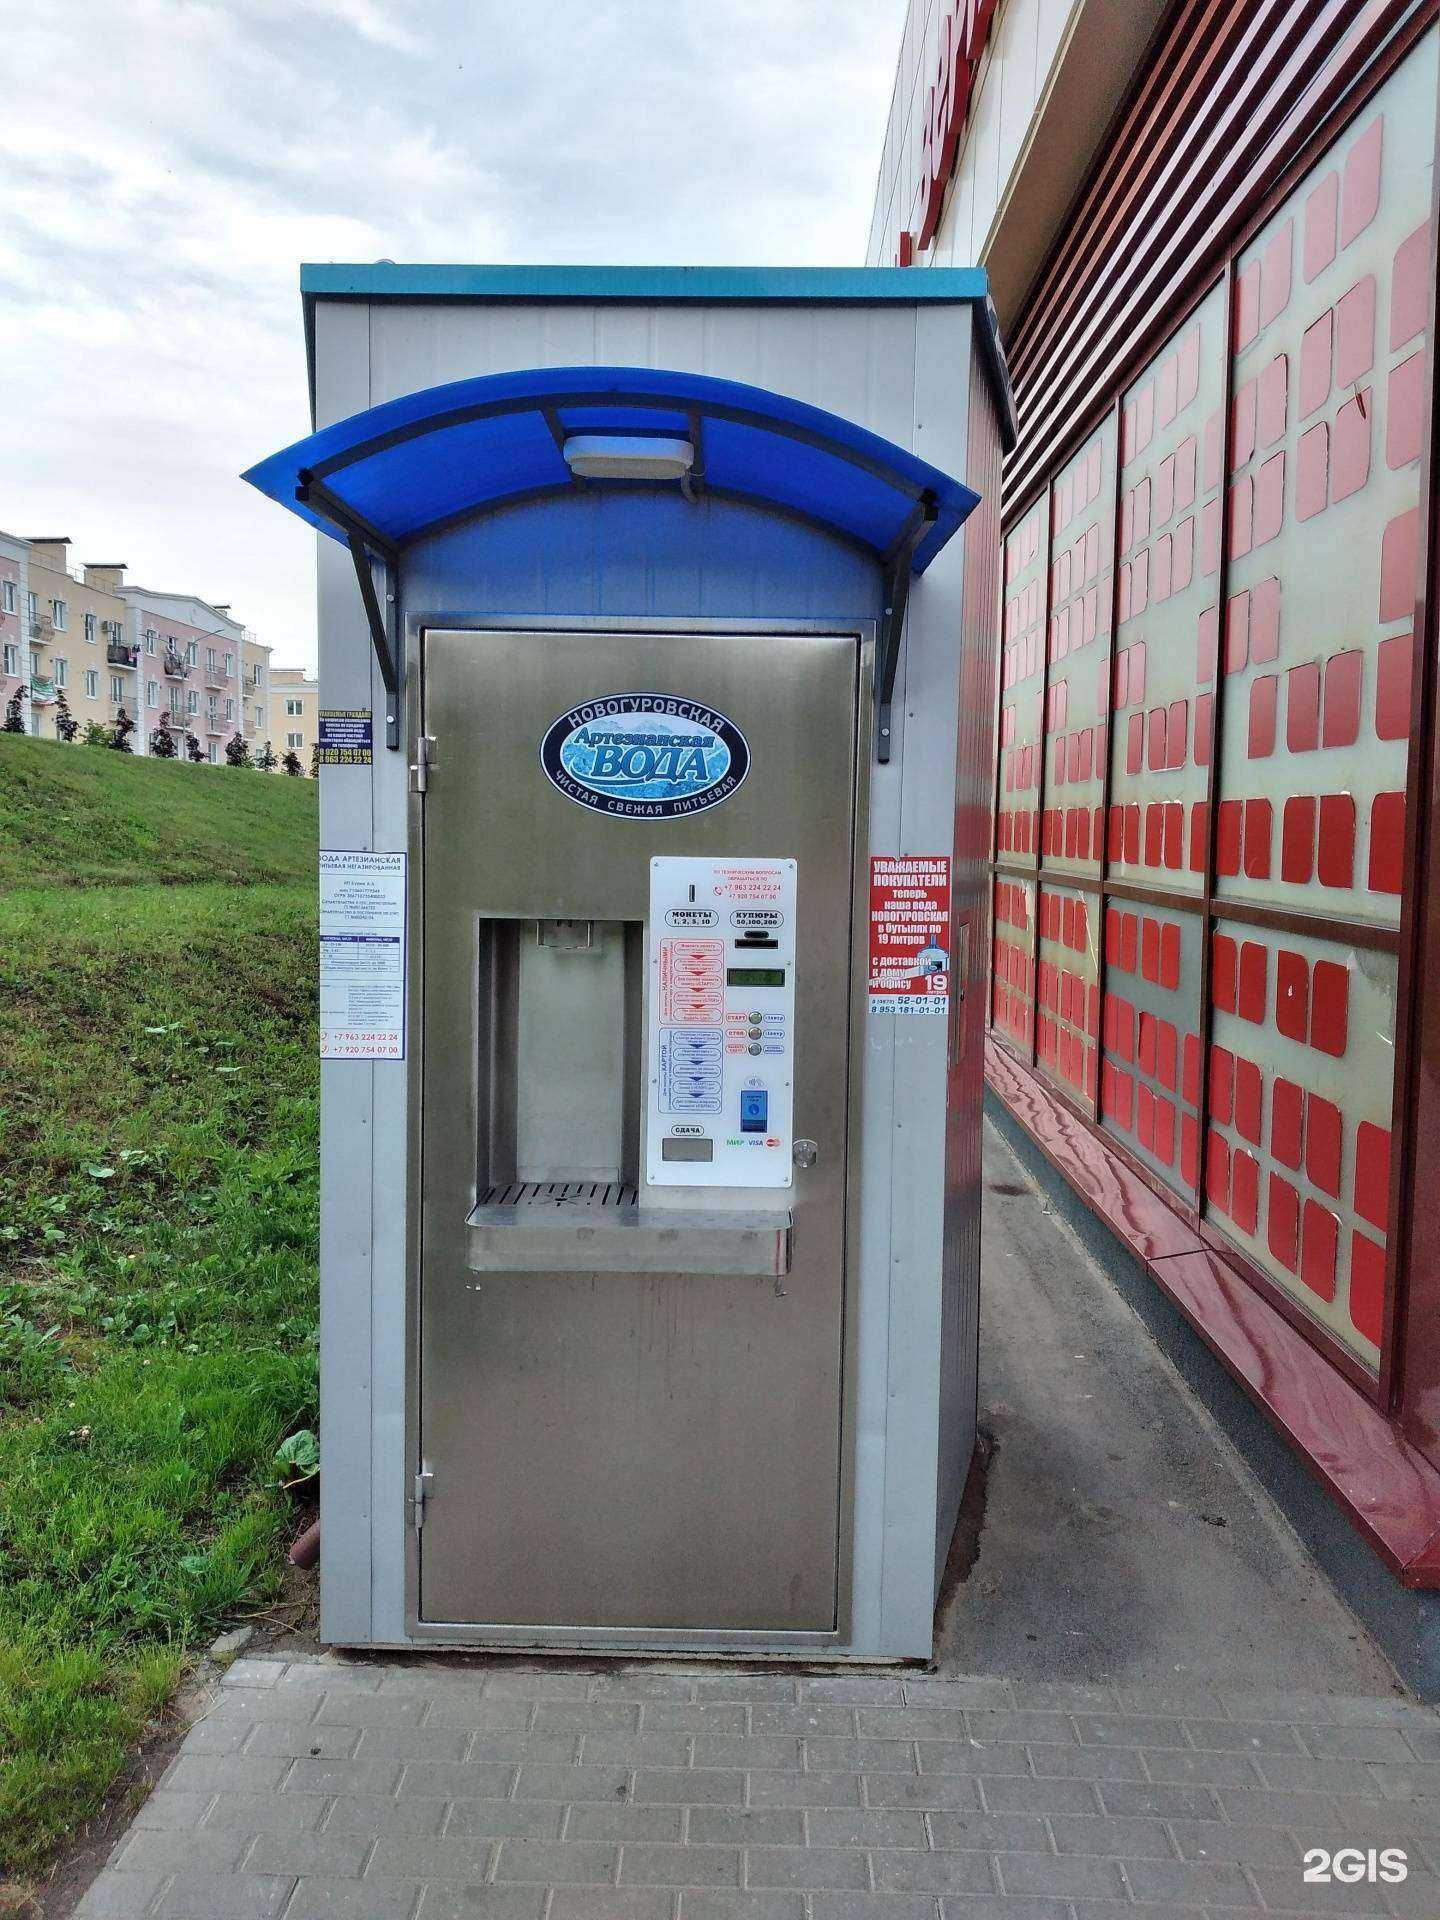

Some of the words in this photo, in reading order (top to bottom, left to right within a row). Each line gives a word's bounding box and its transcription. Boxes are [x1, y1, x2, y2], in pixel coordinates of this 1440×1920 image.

[568, 698, 725, 732] НОВОГУРОВСКАЯ
[574, 727, 716, 748] Артезианская
[591, 745, 710, 784] ВОДА
[555, 769, 598, 805] ЧИСТАЯ
[607, 800, 663, 814] СВЕЖАЯ
[673, 775, 736, 813] ПИТЬЕВАЯ
[342, 855, 401, 864] АРТЕЗИАНСКАЯ
[347, 863, 401, 871] НЕГАЗИРОВАННАЯ
[873, 861, 947, 873] УВАЖАЕМЫЕ
[873, 874, 947, 886] ПОКУПАТЕЛИ
[892, 889, 928, 899] теперь
[884, 901, 911, 910] наша
[912, 901, 938, 911] вода
[871, 911, 949, 922] НОВОГУРОВСКАЯ
[878, 924, 885, 933] в
[886, 922, 928, 934] бутылях
[929, 924, 942, 933] по
[877, 933, 889, 944] 19
[889, 935, 926, 946] литров
[872, 956, 879, 966] с
[880, 956, 931, 966] доставкой
[879, 968, 906, 978] дому
[872, 979, 879, 989] и
[880, 979, 911, 990] офису
[925, 974, 948, 991] 19
[897, 996, 946, 1005] 52-01-01
[898, 1006, 946, 1014] 181-01-01
[377, 1033, 387, 1041] 22
[388, 1033, 398, 1041] 24
